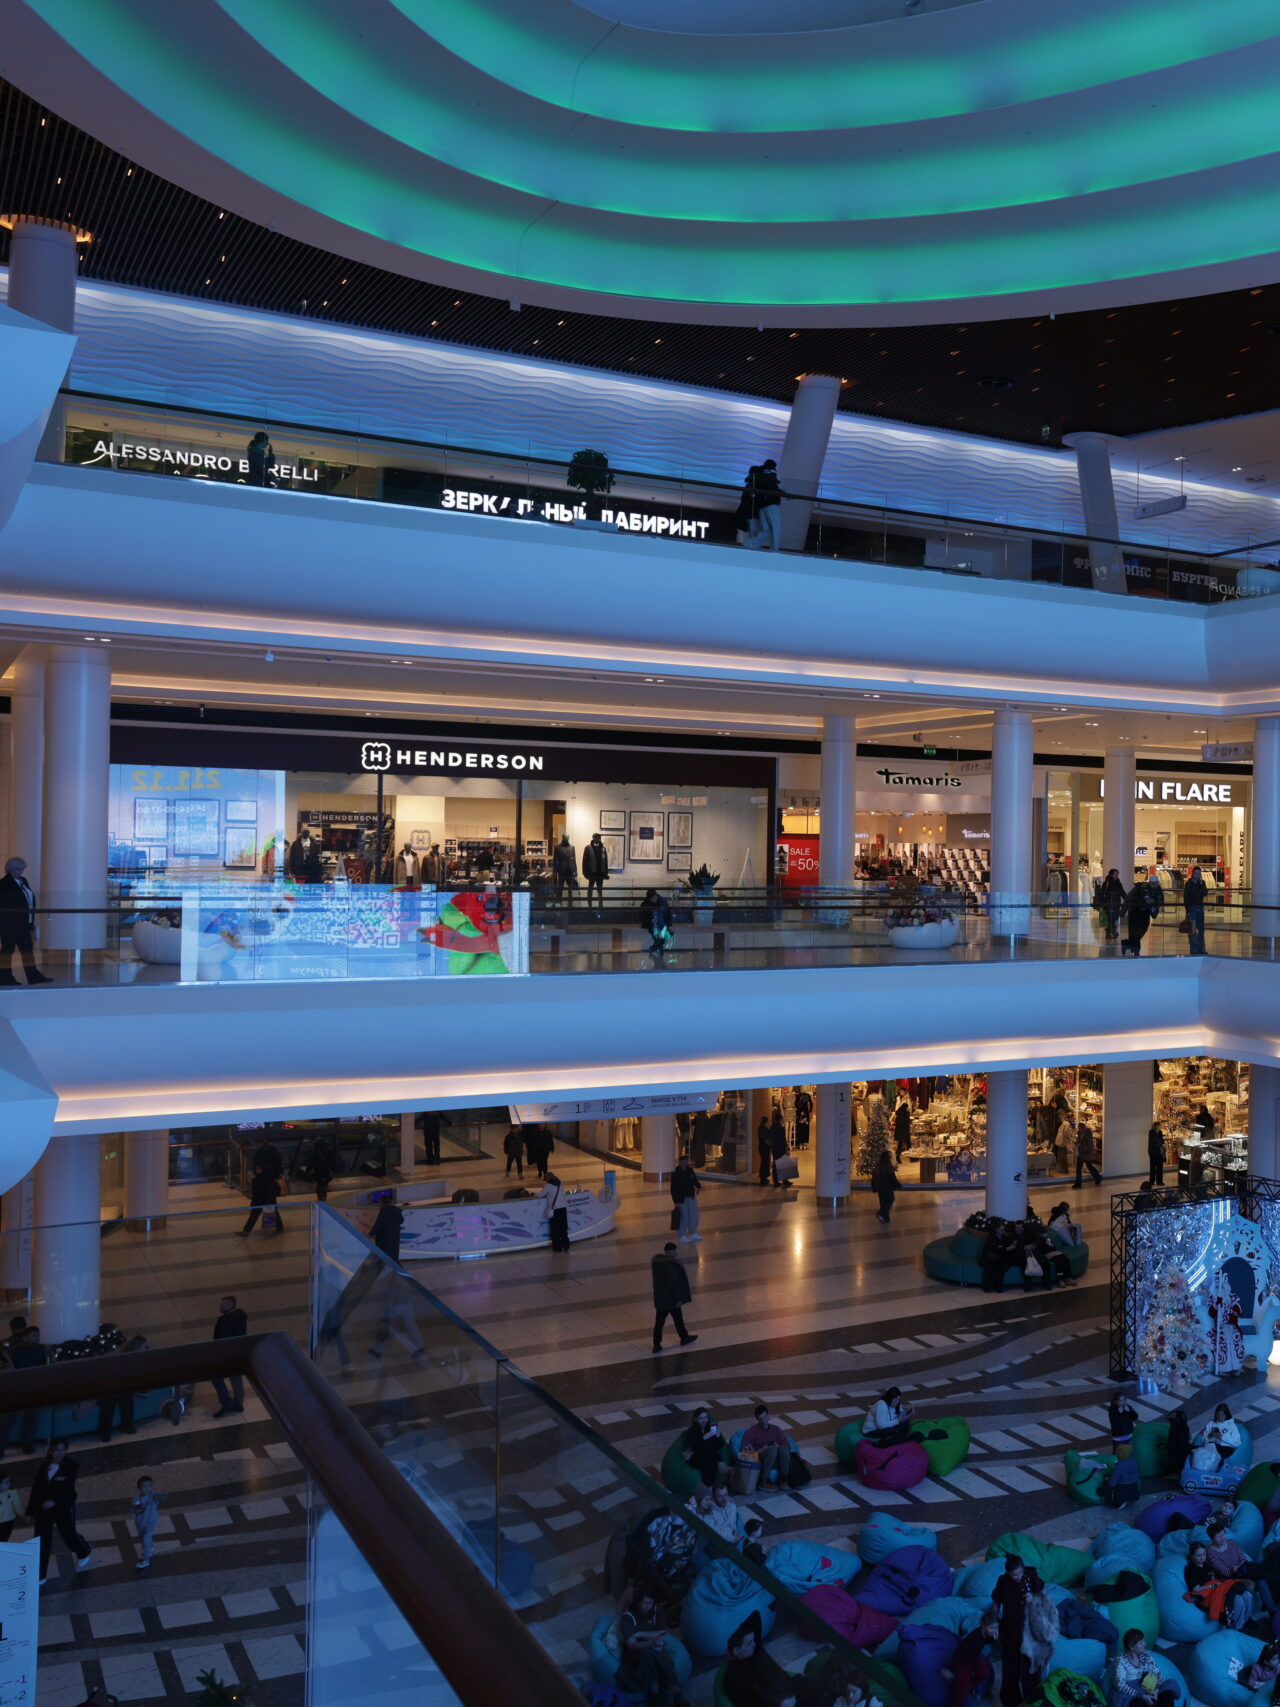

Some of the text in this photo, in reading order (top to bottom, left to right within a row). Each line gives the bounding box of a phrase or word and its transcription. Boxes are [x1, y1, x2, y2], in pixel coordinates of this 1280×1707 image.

[93, 440, 318, 482] ALESSANDRO BRELLI
[441, 489, 587, 522] ЗЕРКЛНЫЙ
[397, 750, 543, 770] HENDERSON
[876, 768, 962, 787] Tamaris
[1162, 781, 1231, 802] FLARE
[322, 814, 378, 822] HENDERSON
[962, 828, 990, 839] Tamaris
[790, 847, 810, 856] SALE
[19, 1565, 27, 1576] 3
[18, 1591, 26, 1601] 2
